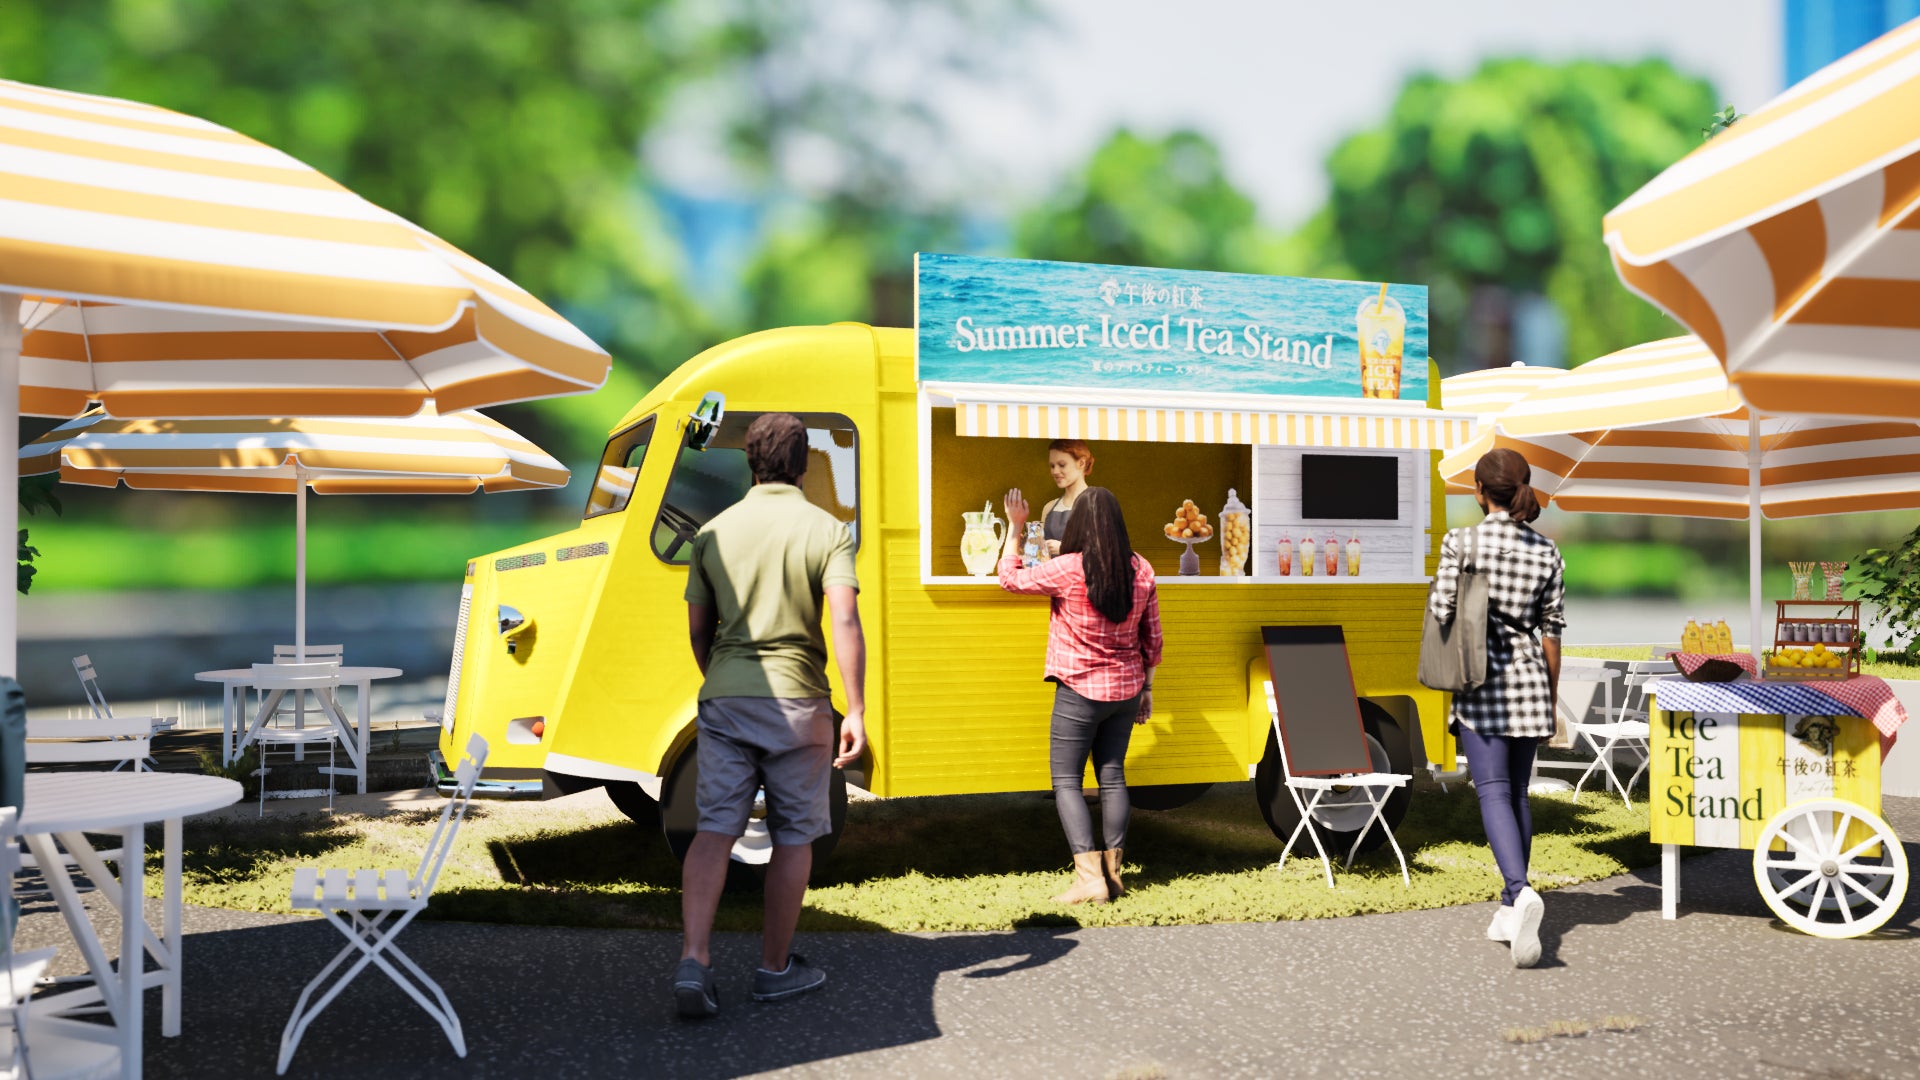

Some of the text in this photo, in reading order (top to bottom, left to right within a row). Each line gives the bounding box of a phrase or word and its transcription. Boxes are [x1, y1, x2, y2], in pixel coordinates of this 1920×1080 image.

[1123, 282, 1204, 310] 午後の紅茶
[955, 313, 1333, 370] Summer Iced Tea Stand
[1366, 364, 1396, 377] ICE
[1366, 377, 1397, 390] TEA
[1667, 711, 1718, 741] Ice
[1666, 745, 1725, 780] Tea
[1776, 757, 1858, 778] 午後の紅茶
[1666, 785, 1765, 821] Stand
